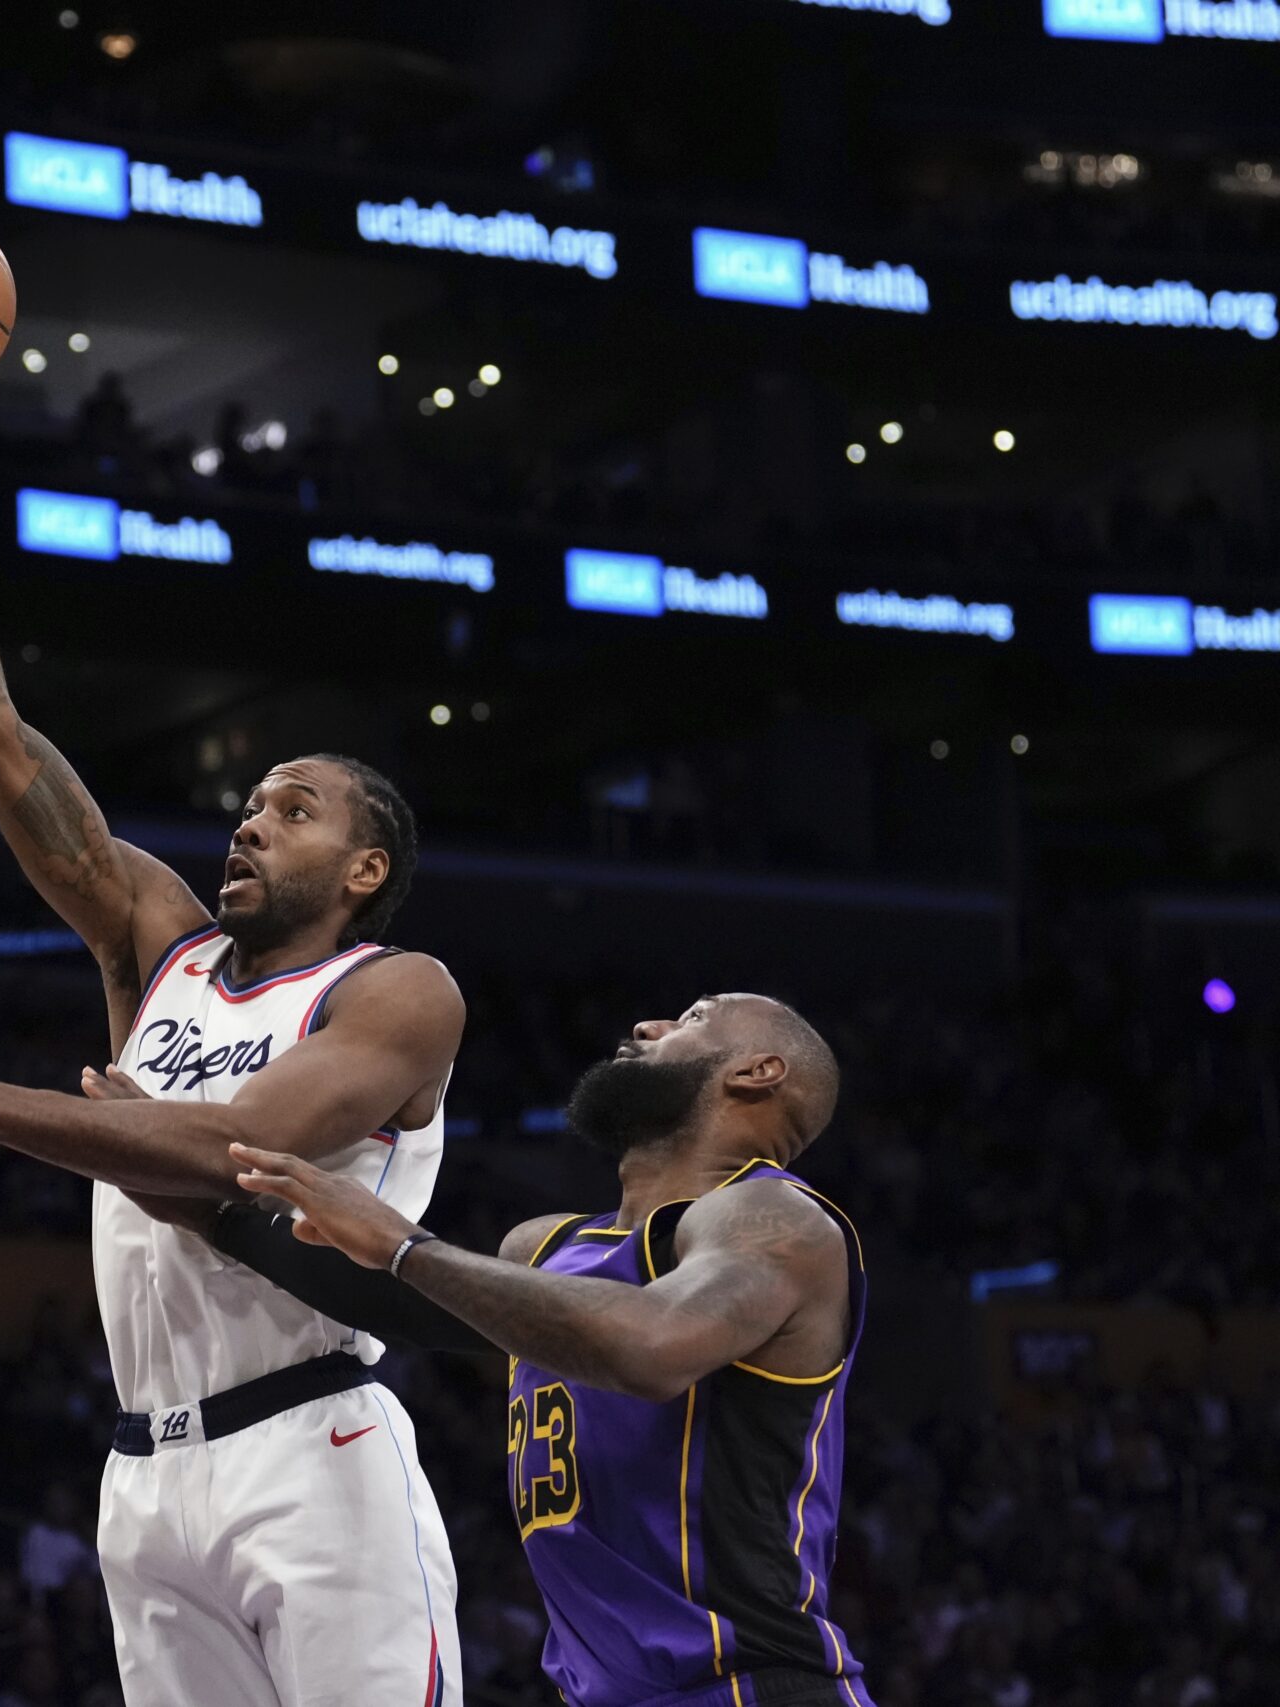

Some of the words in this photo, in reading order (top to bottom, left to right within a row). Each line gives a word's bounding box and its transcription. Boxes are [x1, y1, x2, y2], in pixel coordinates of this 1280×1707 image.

[22, 155, 111, 198] UCLA
[129, 161, 262, 226] Health
[356, 199, 617, 279] uclahealth.org
[809, 252, 929, 312] Health
[1009, 275, 1278, 339] uclahealth.org
[120, 510, 231, 564] Health
[663, 566, 768, 617] Health
[137, 1018, 273, 1091] Clippers
[159, 1410, 190, 1443] LA
[508, 1381, 581, 1543] 23
